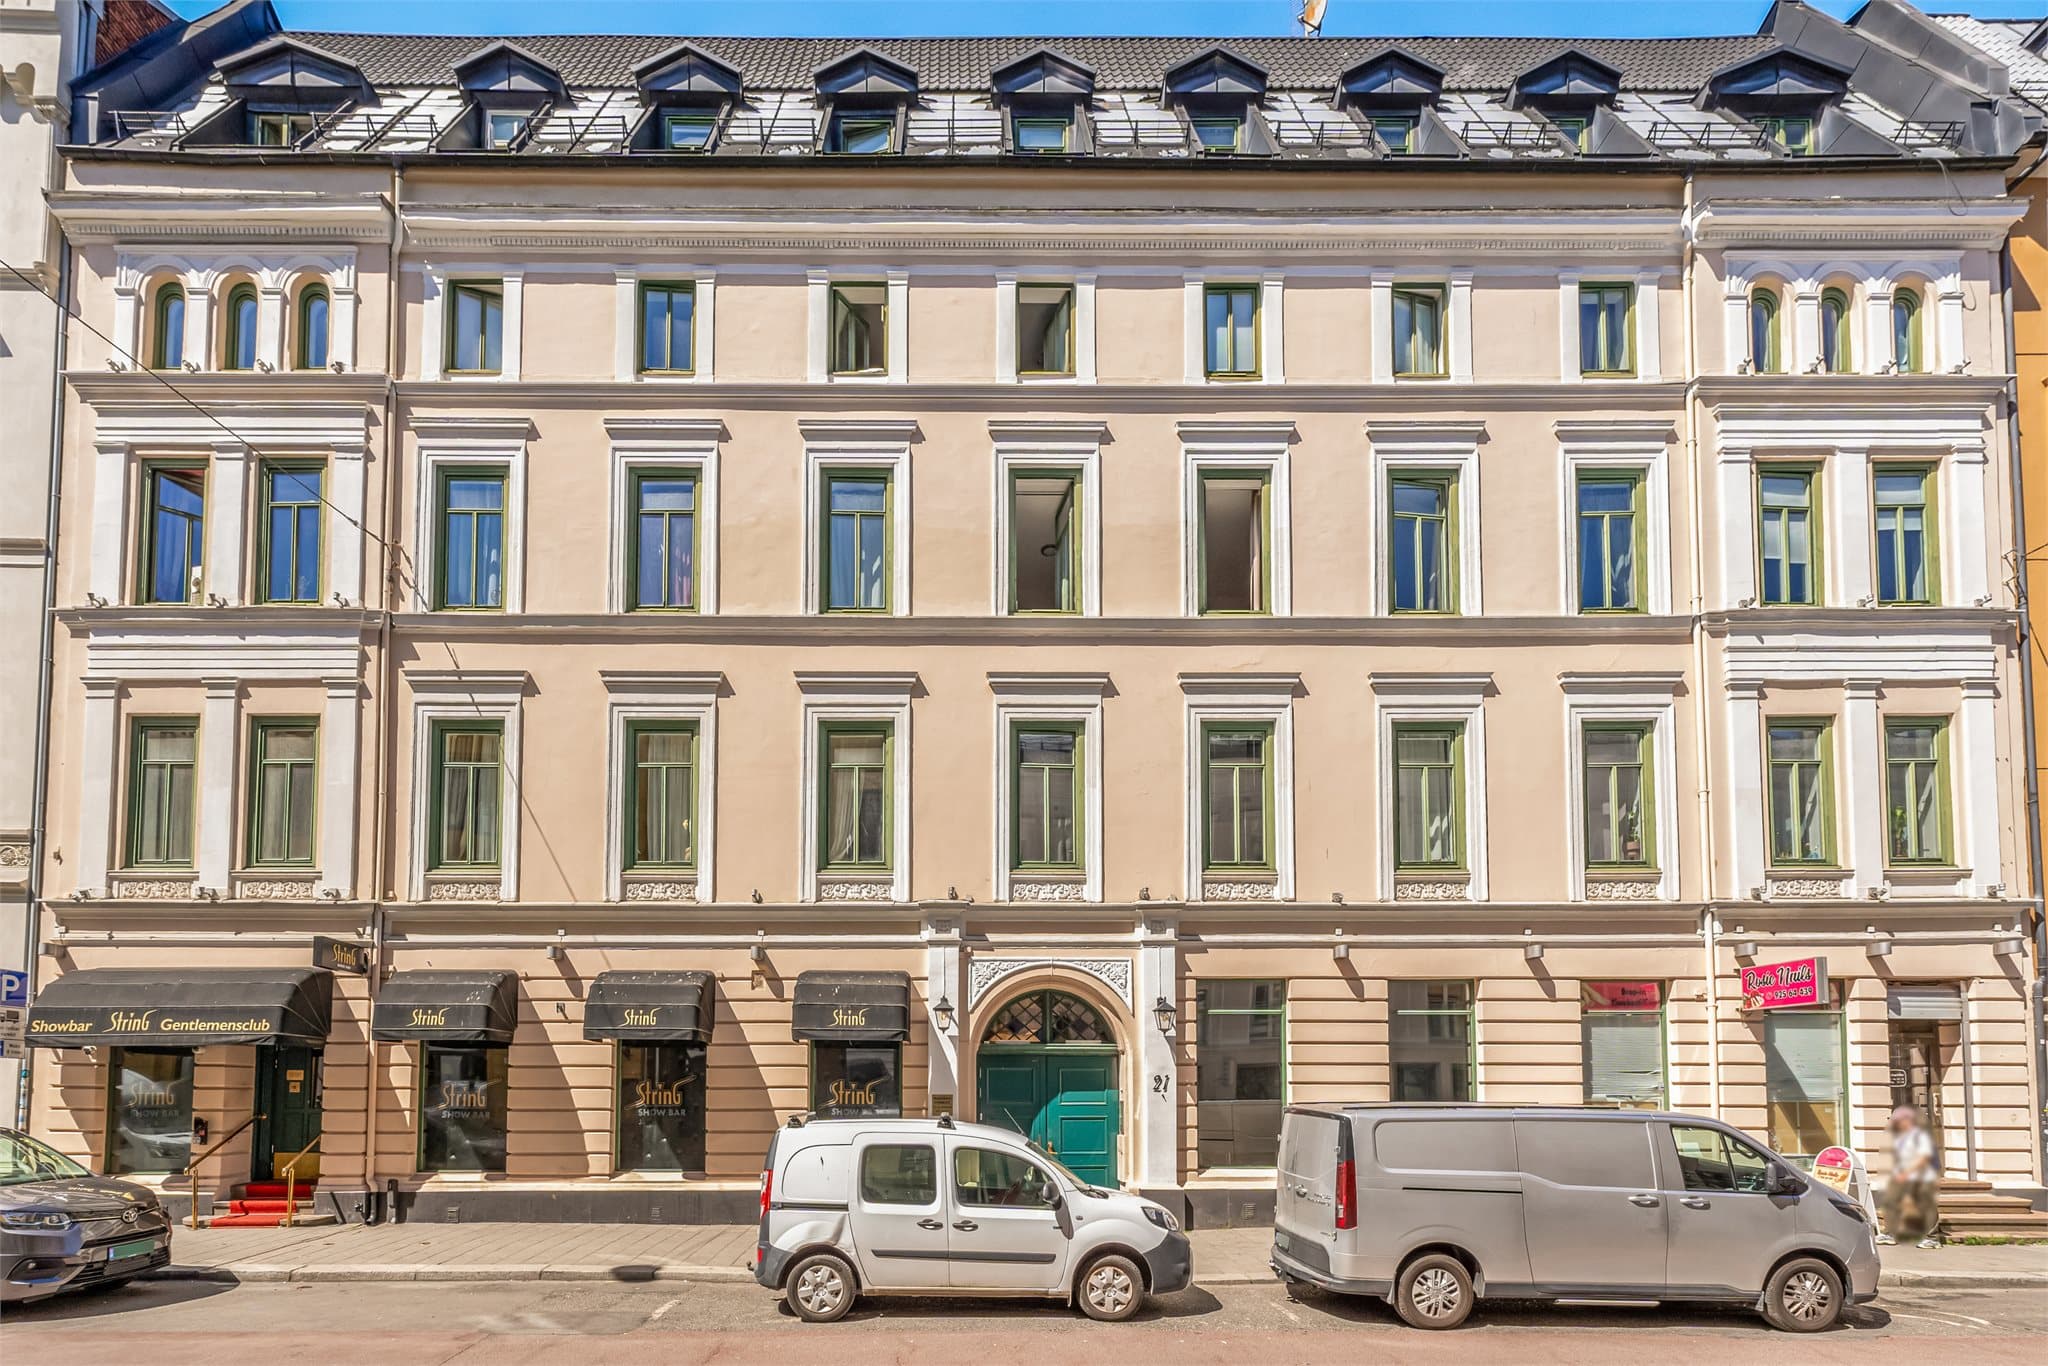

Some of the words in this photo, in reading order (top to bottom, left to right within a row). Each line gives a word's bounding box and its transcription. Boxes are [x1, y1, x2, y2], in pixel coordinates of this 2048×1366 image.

[1776, 964, 1813, 986] Nails
[1, 974, 20, 1002] P
[31, 1020, 93, 1033] Showbar
[160, 1018, 271, 1032] Gentlemensclub
[638, 1108, 666, 1117] SHOW
[668, 1108, 686, 1117] BAR
